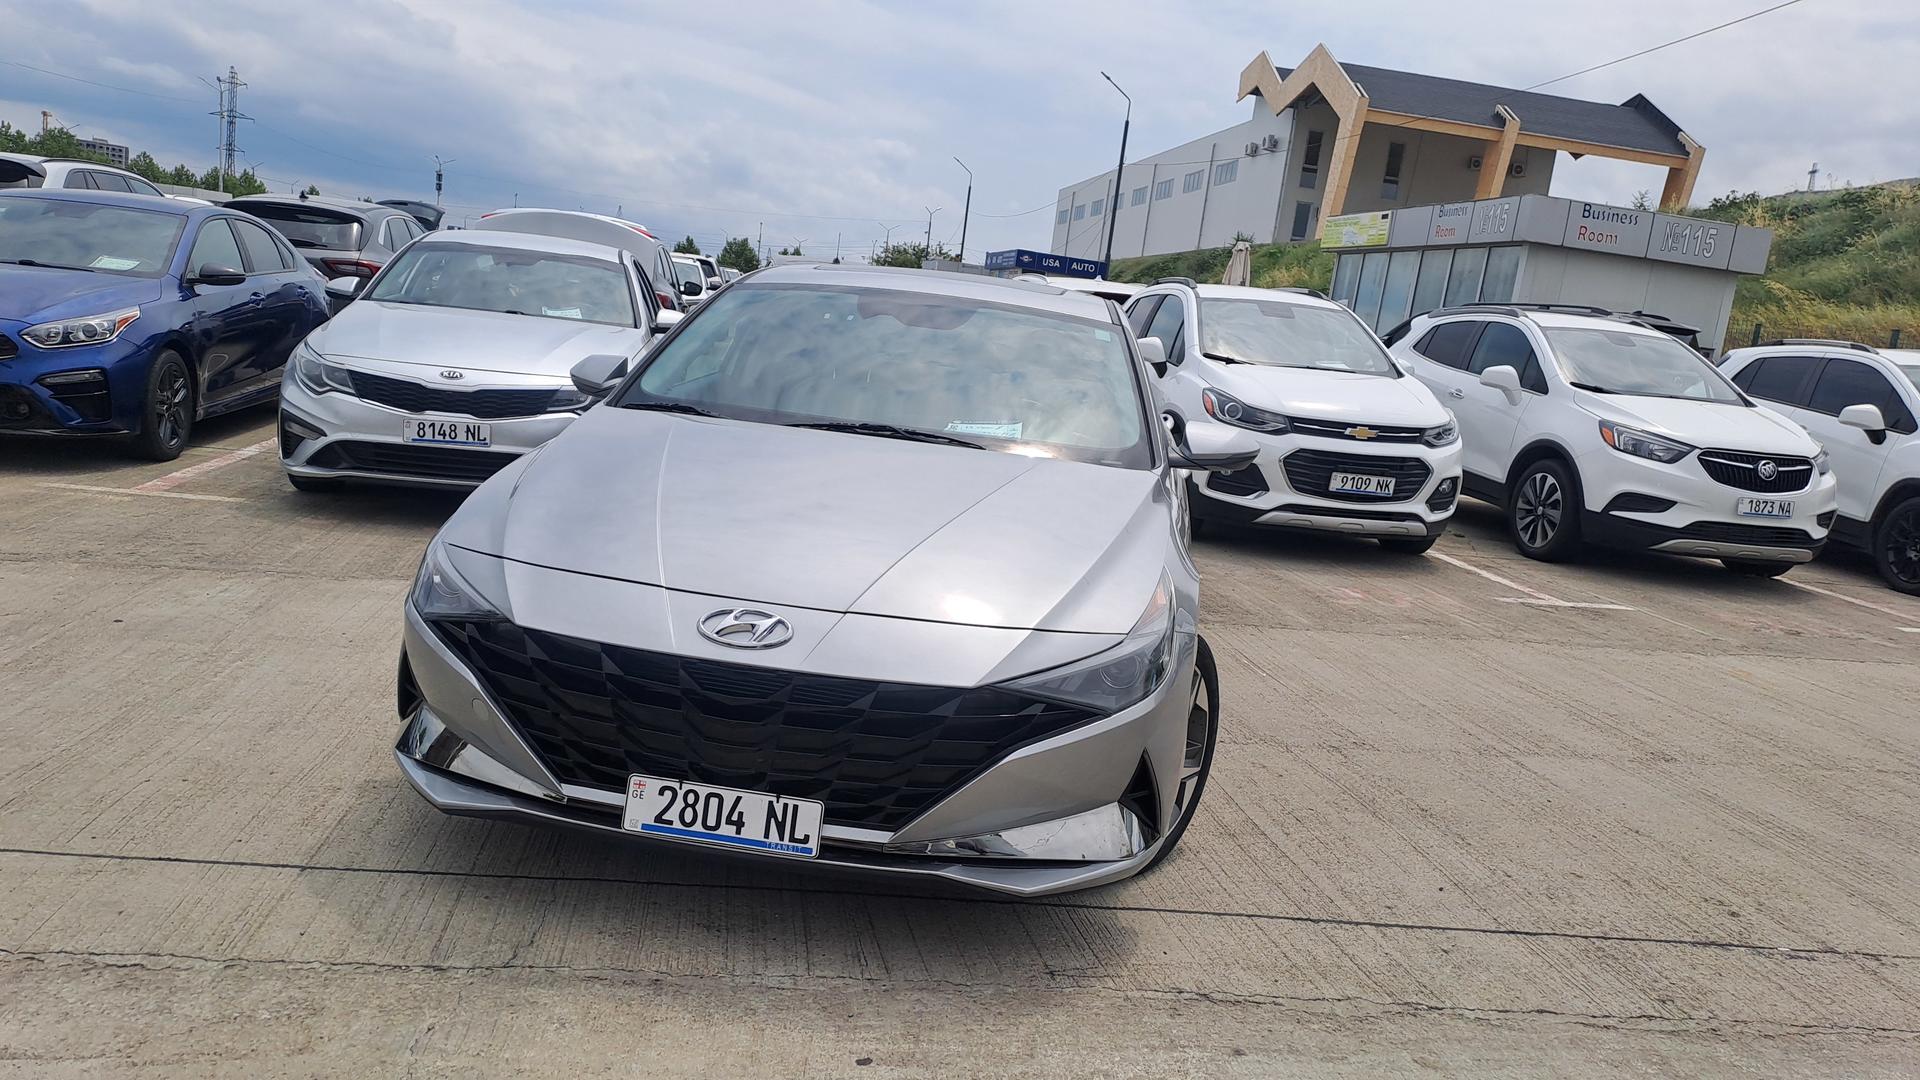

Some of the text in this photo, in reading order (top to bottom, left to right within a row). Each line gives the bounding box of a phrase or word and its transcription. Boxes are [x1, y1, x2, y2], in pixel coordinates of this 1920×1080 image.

[1438, 204, 1468, 218] Business
[1582, 203, 1639, 226] Business
[1435, 224, 1456, 238] Room
[1577, 225, 1618, 245] Room
[1660, 221, 1718, 258] №115
[1042, 257, 1096, 273] USA AUTO
[442, 370, 461, 378] KIA
[417, 421, 487, 442] 8148 NL
[1341, 475, 1393, 493] 9109 NK
[1748, 499, 1792, 516] 1873 NA
[632, 789, 645, 800] GE
[653, 785, 810, 845] 2804 NL
[766, 841, 803, 854] TRANSIT
